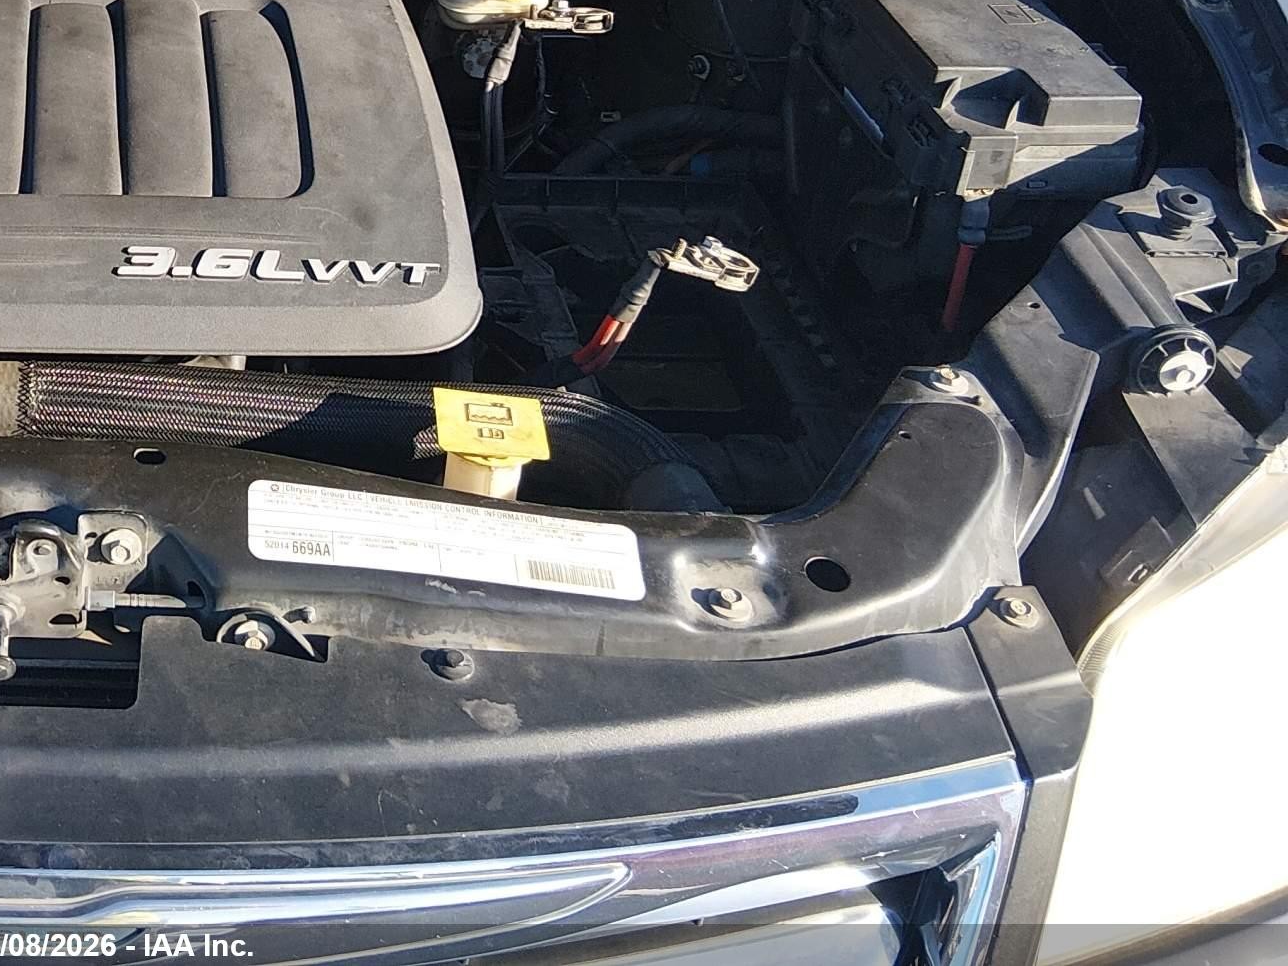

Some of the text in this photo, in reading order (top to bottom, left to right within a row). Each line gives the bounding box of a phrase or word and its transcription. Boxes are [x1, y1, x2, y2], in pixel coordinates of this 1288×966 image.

[285, 484, 318, 496] Chrysler
[320, 489, 345, 499] Group
[347, 492, 363, 501] LLC
[369, 495, 402, 506] VEHICLE
[404, 499, 443, 511] EMISSION
[444, 504, 481, 516] CONTROL
[483, 509, 540, 524] INFORMATION
[292, 540, 331, 557] 669AA
